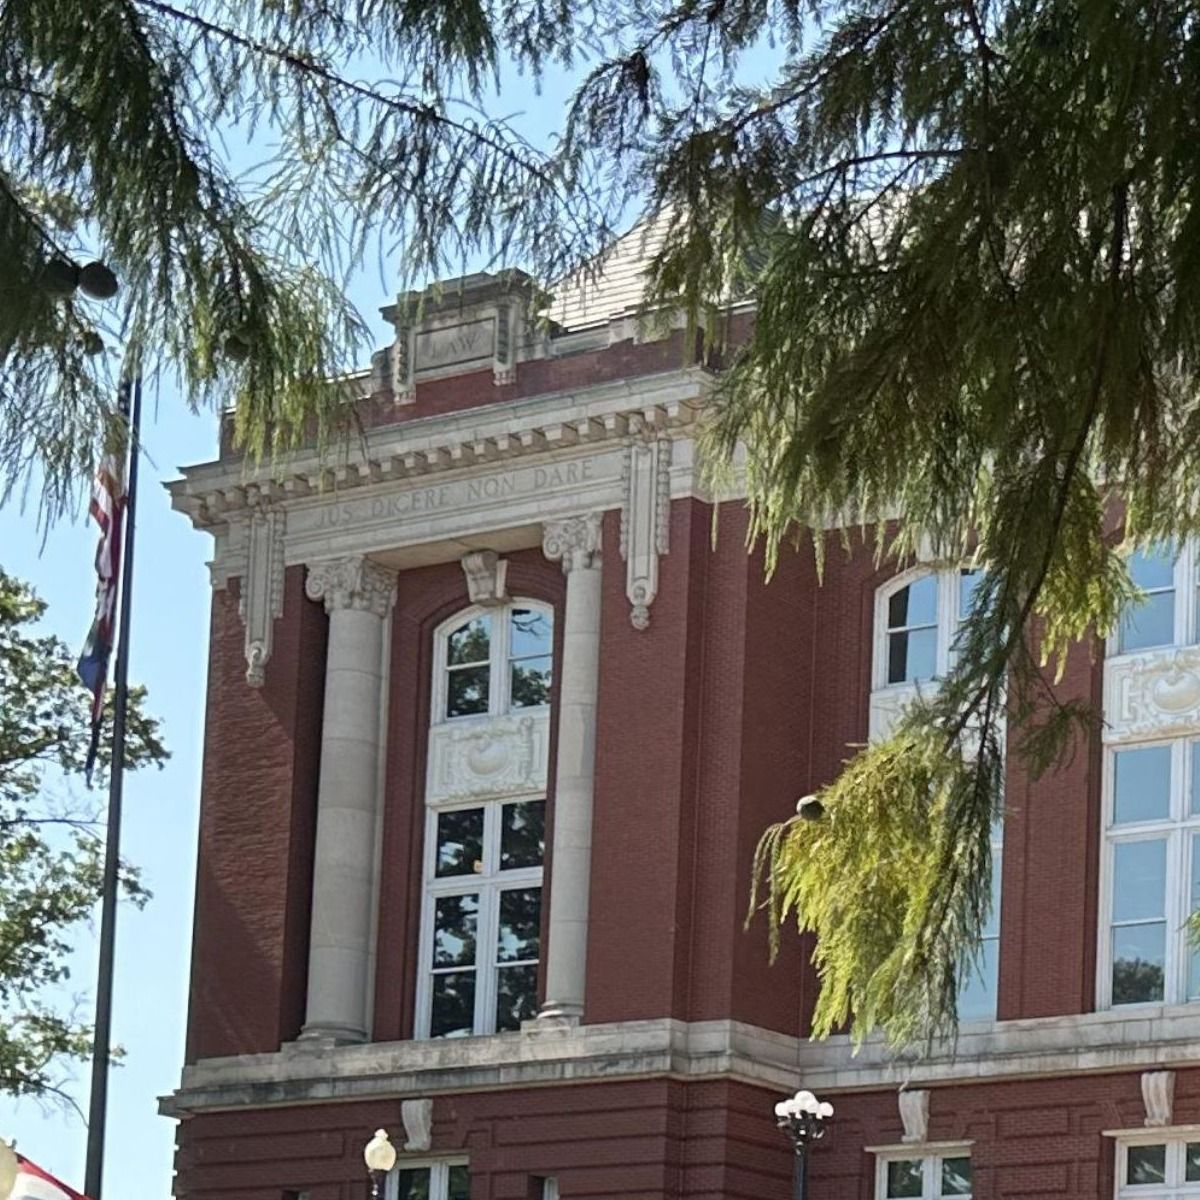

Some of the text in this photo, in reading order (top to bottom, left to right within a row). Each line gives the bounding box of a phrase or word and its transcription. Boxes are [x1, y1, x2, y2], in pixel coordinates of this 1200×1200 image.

[370, 486, 450, 518] DICERE
[466, 475, 516, 500] NON
[532, 459, 594, 489] DARE
